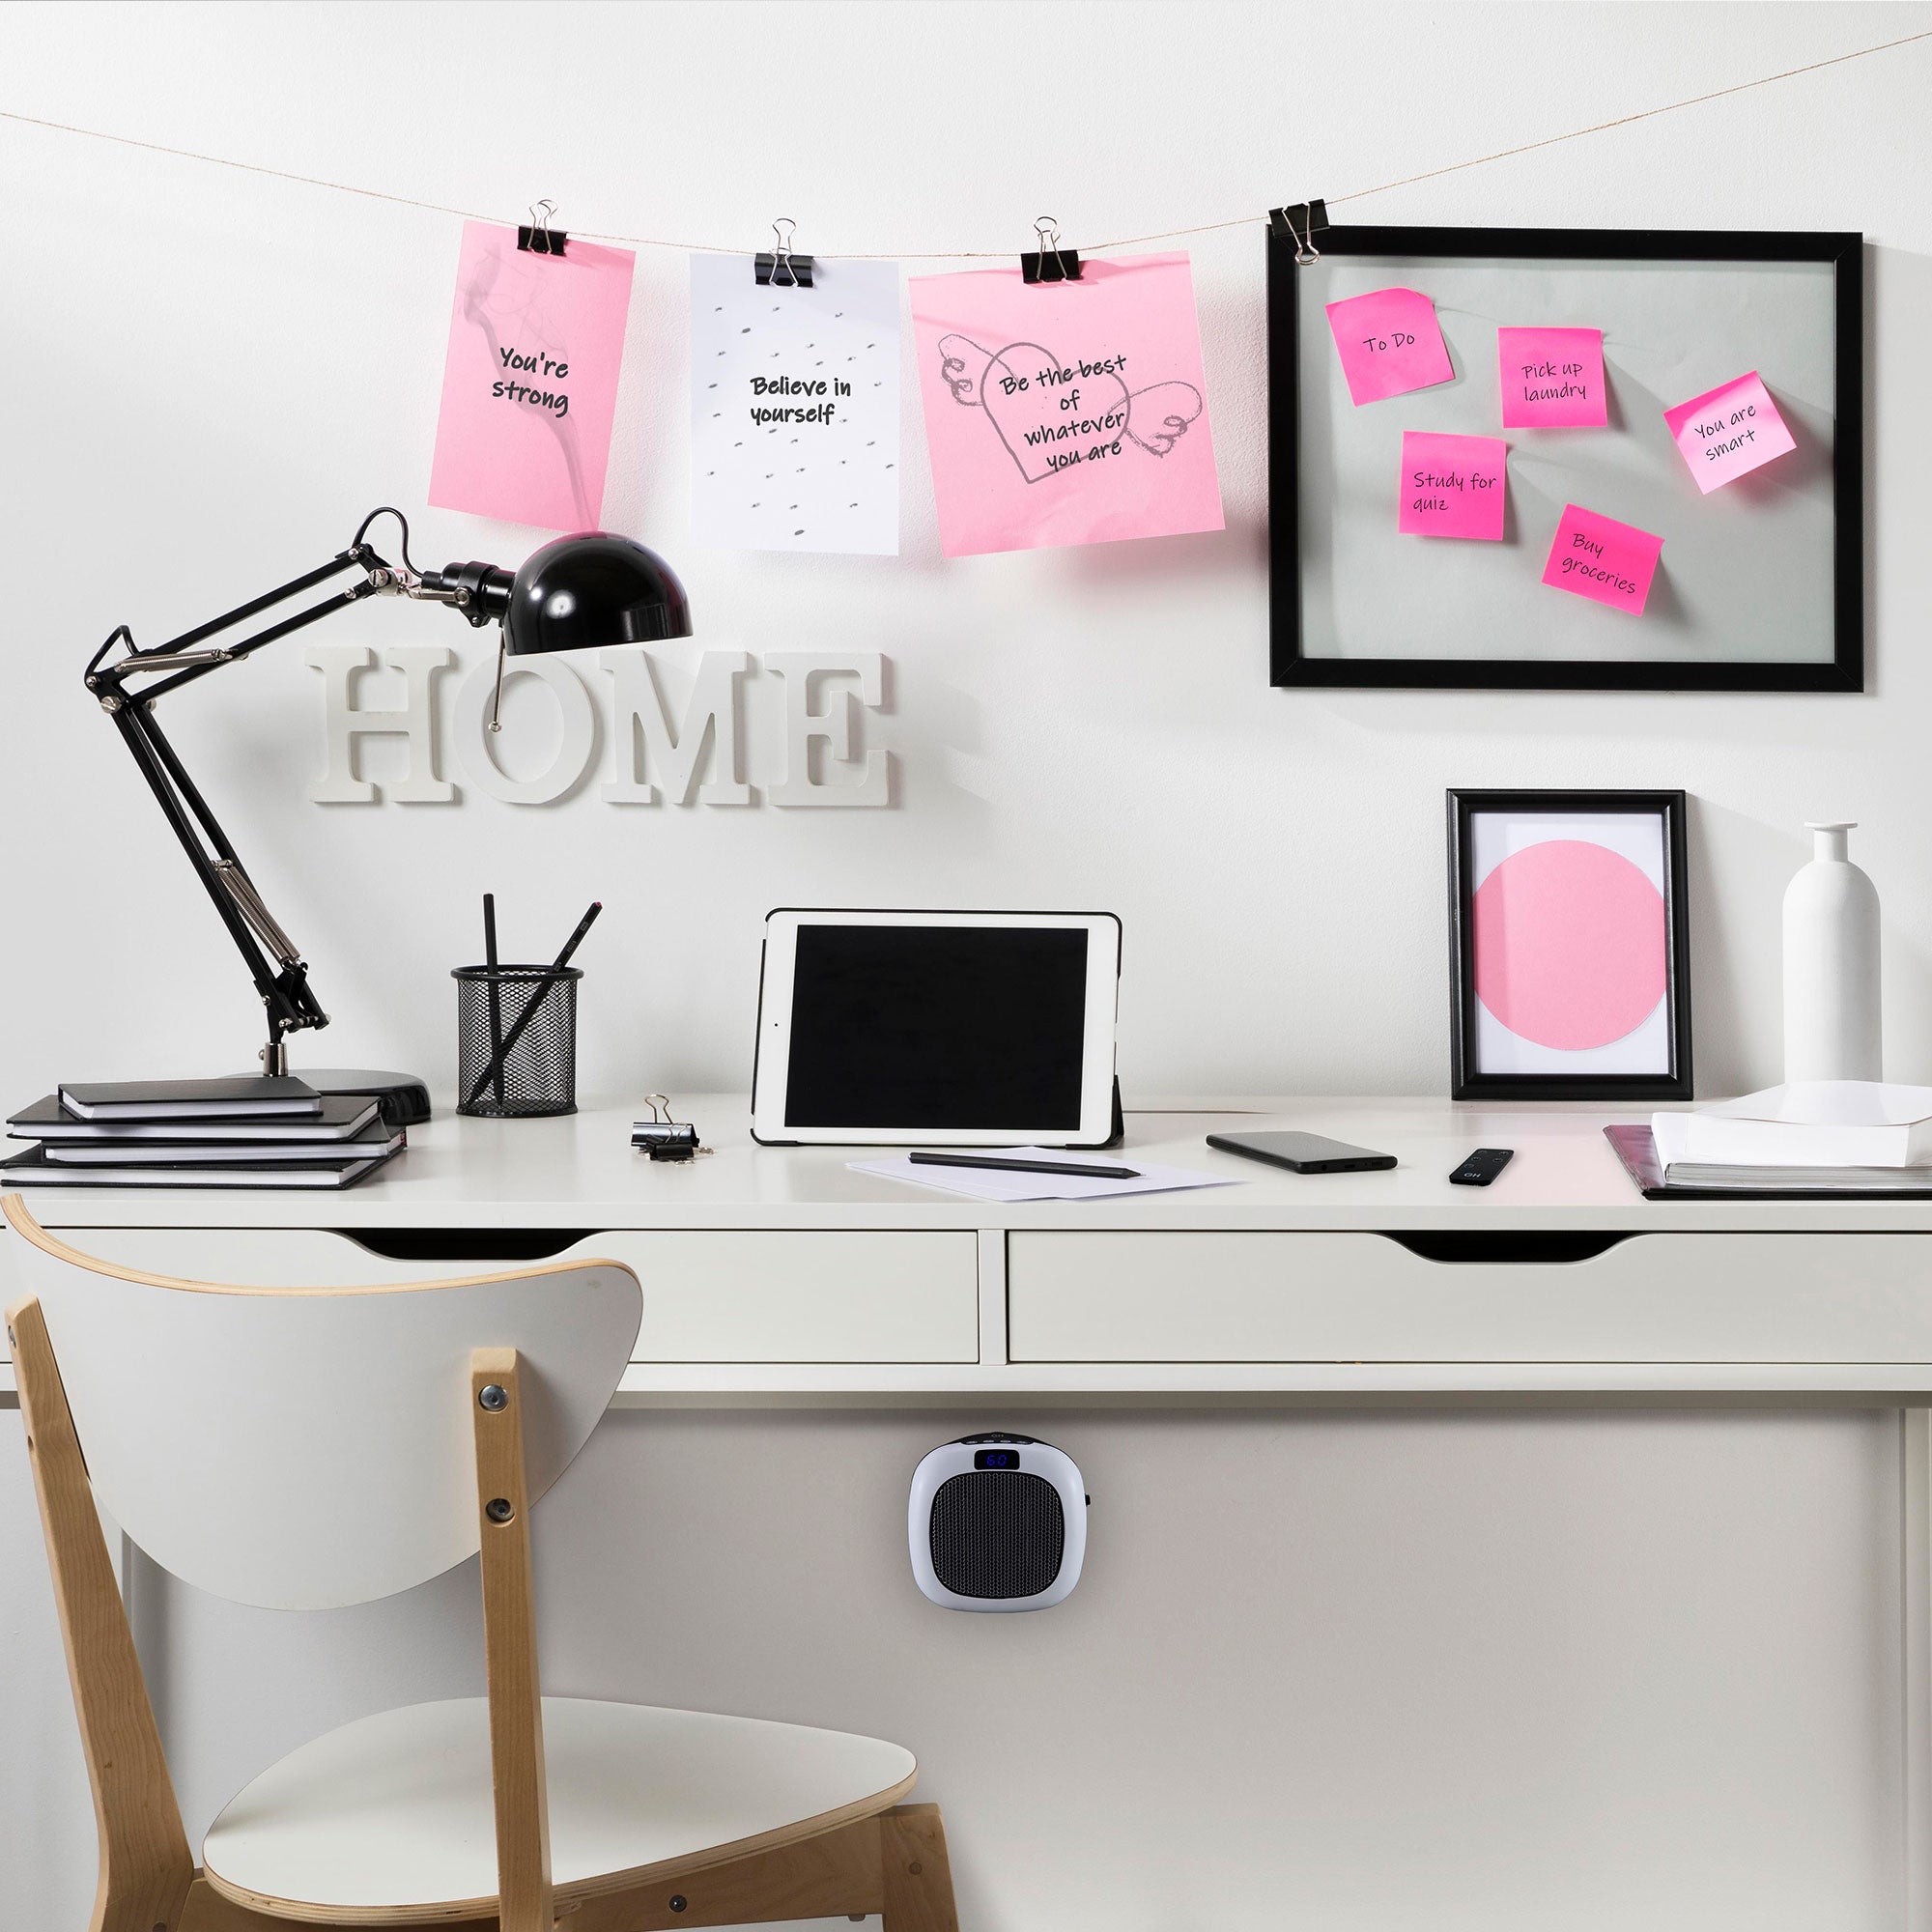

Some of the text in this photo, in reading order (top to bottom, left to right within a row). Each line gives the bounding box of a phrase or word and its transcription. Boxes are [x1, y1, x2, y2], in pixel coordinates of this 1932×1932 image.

[1363, 332, 1415, 353] To Do
[499, 347, 569, 379] You're
[999, 355, 1126, 395] Be the best
[492, 381, 570, 418] strong
[750, 376, 851, 397] Believe in
[1060, 388, 1080, 411] of
[1523, 382, 1587, 402] laundry
[750, 403, 836, 427] yourself
[1694, 404, 1756, 440] You are
[1023, 415, 1124, 446] whatever
[1705, 428, 1755, 462] smart
[1046, 441, 1122, 472] you are
[1413, 471, 1497, 493] Study for
[1412, 495, 1448, 513] quiz
[1573, 532, 1604, 559] Buy
[1560, 557, 1636, 596] groceries
[304, 646, 890, 808] HOME
[986, 1454, 1007, 1466] 60
